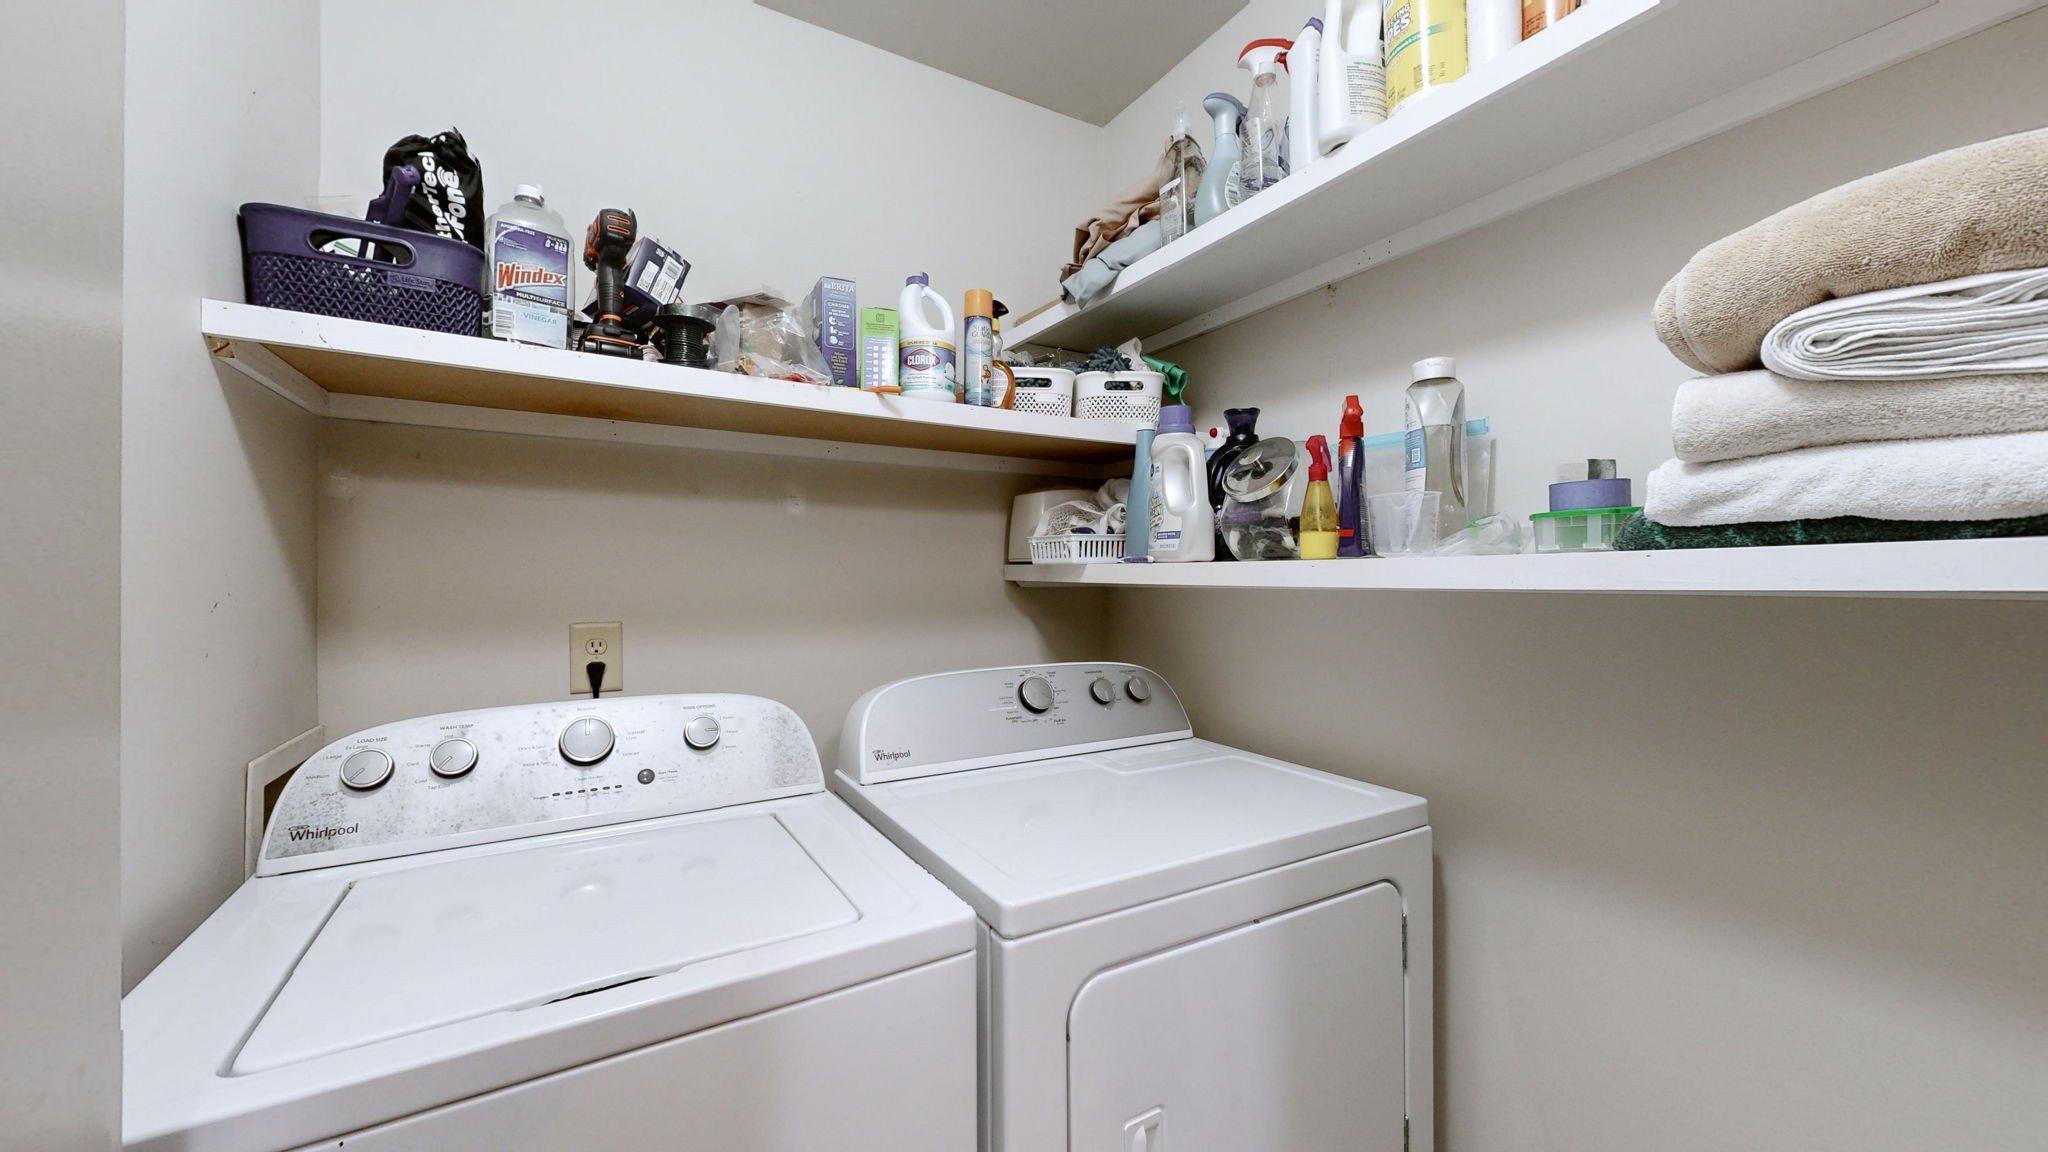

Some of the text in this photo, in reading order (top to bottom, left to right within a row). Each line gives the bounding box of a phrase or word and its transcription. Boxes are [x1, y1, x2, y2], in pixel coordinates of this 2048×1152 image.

[496, 261, 567, 292] Windex
[831, 281, 855, 293] BRITA
[516, 292, 566, 308] MULTISURFACE
[522, 312, 557, 326] VINEGAR
[907, 354, 938, 367] CLOROX
[873, 748, 911, 762] Whirlpool
[289, 822, 359, 842] Whirlpool
